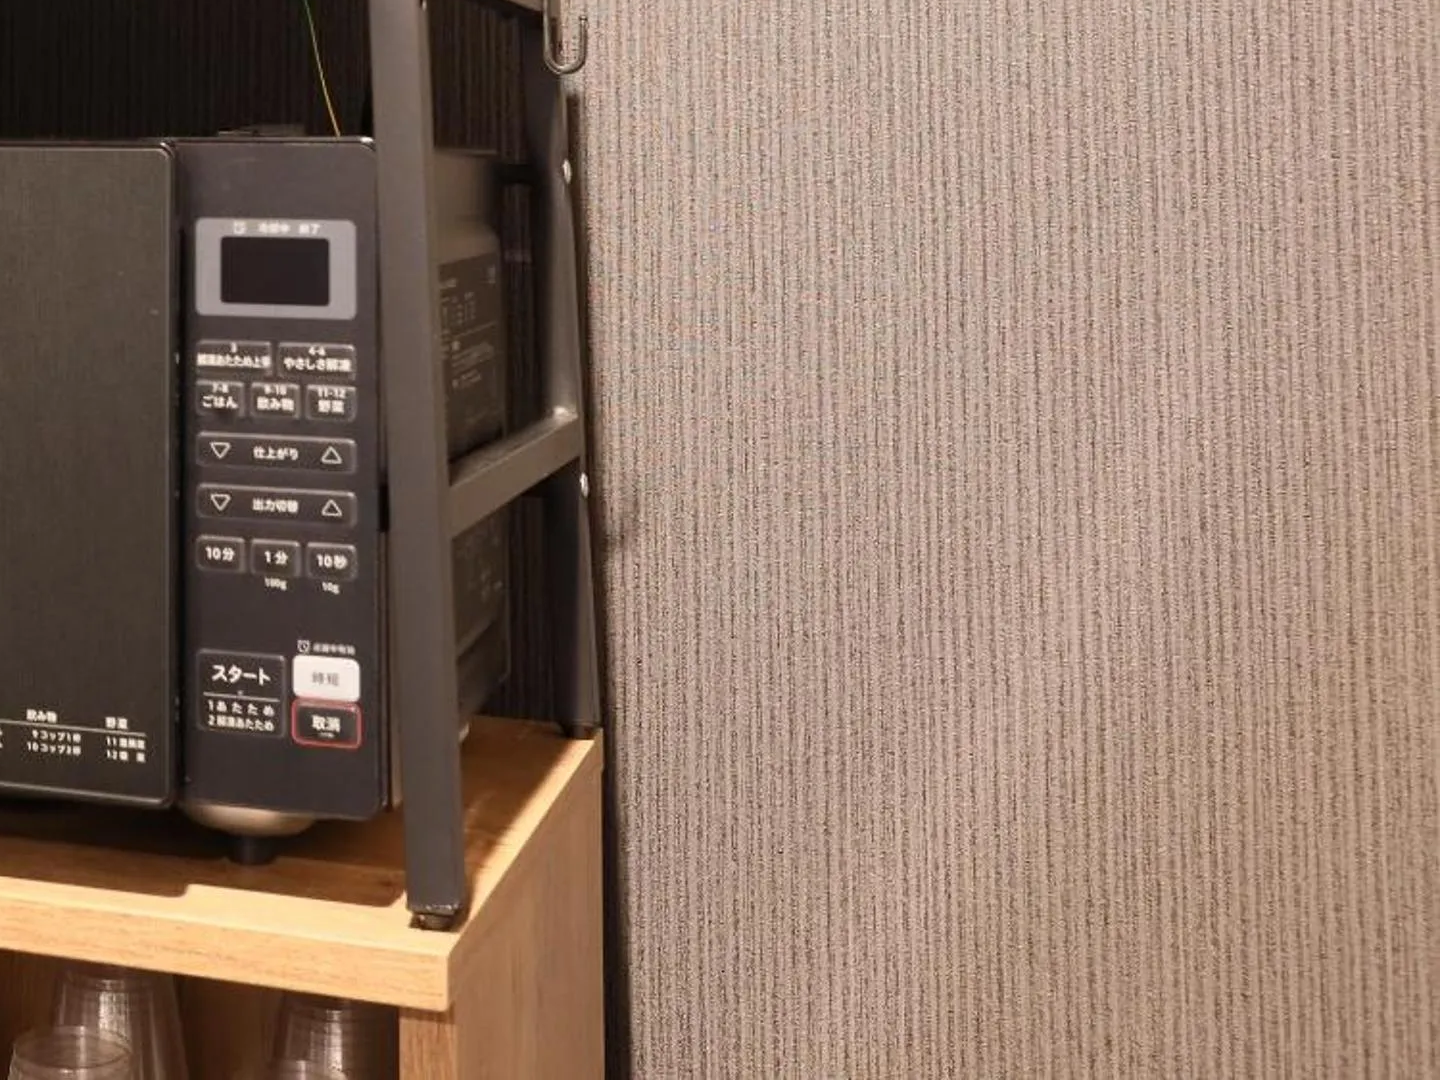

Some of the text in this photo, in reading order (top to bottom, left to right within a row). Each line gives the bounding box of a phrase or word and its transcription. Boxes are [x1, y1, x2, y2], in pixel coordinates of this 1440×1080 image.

[202, 395, 239, 409] ごはん
[253, 446, 299, 461] 仕上がり
[205, 545, 235, 561] 10分
[316, 554, 348, 570] 10秒
[211, 664, 271, 686] スタート
[312, 715, 341, 733] 取消
